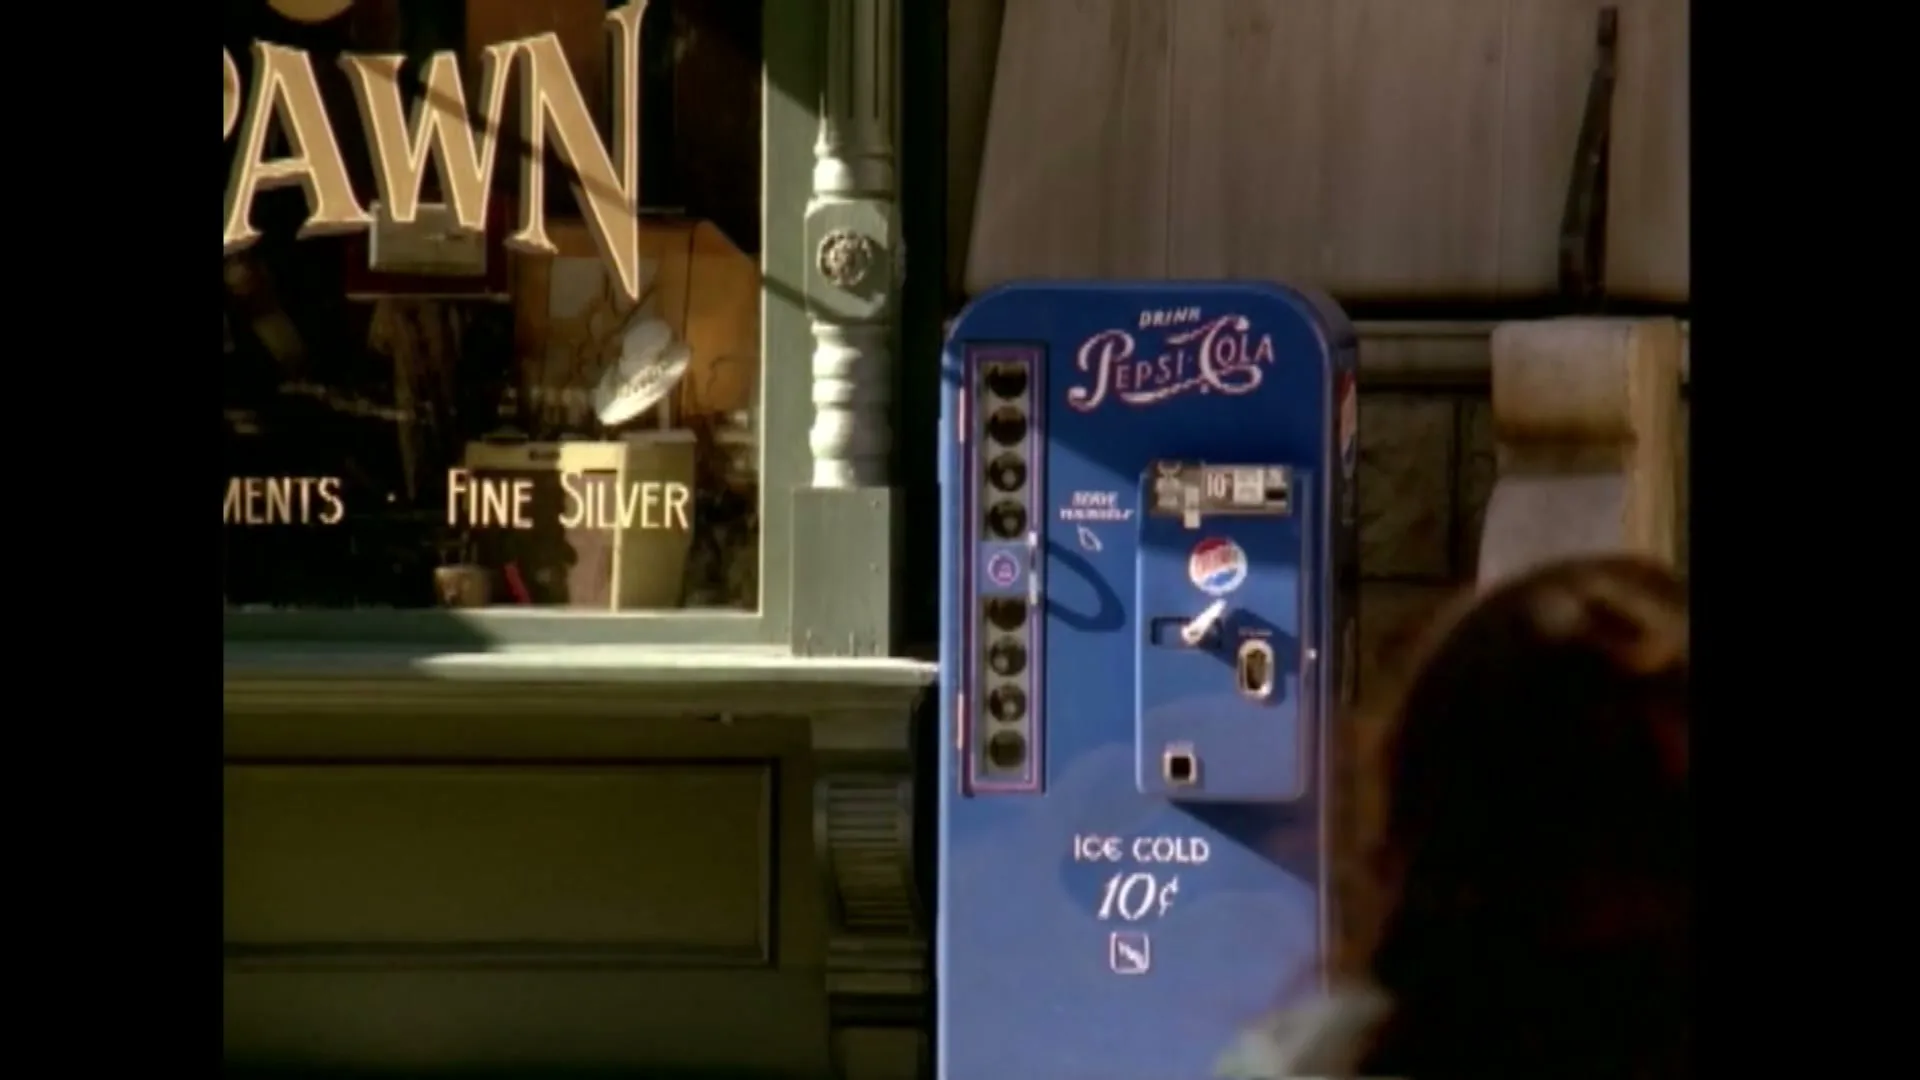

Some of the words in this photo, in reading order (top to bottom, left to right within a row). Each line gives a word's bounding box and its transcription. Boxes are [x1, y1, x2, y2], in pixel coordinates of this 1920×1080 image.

[224, 0, 646, 300] AWN
[1138, 306, 1201, 330] DRINK
[1074, 834, 1123, 862] ICE
[1132, 836, 1210, 863] COLD
[1098, 871, 1178, 920] 10¢
